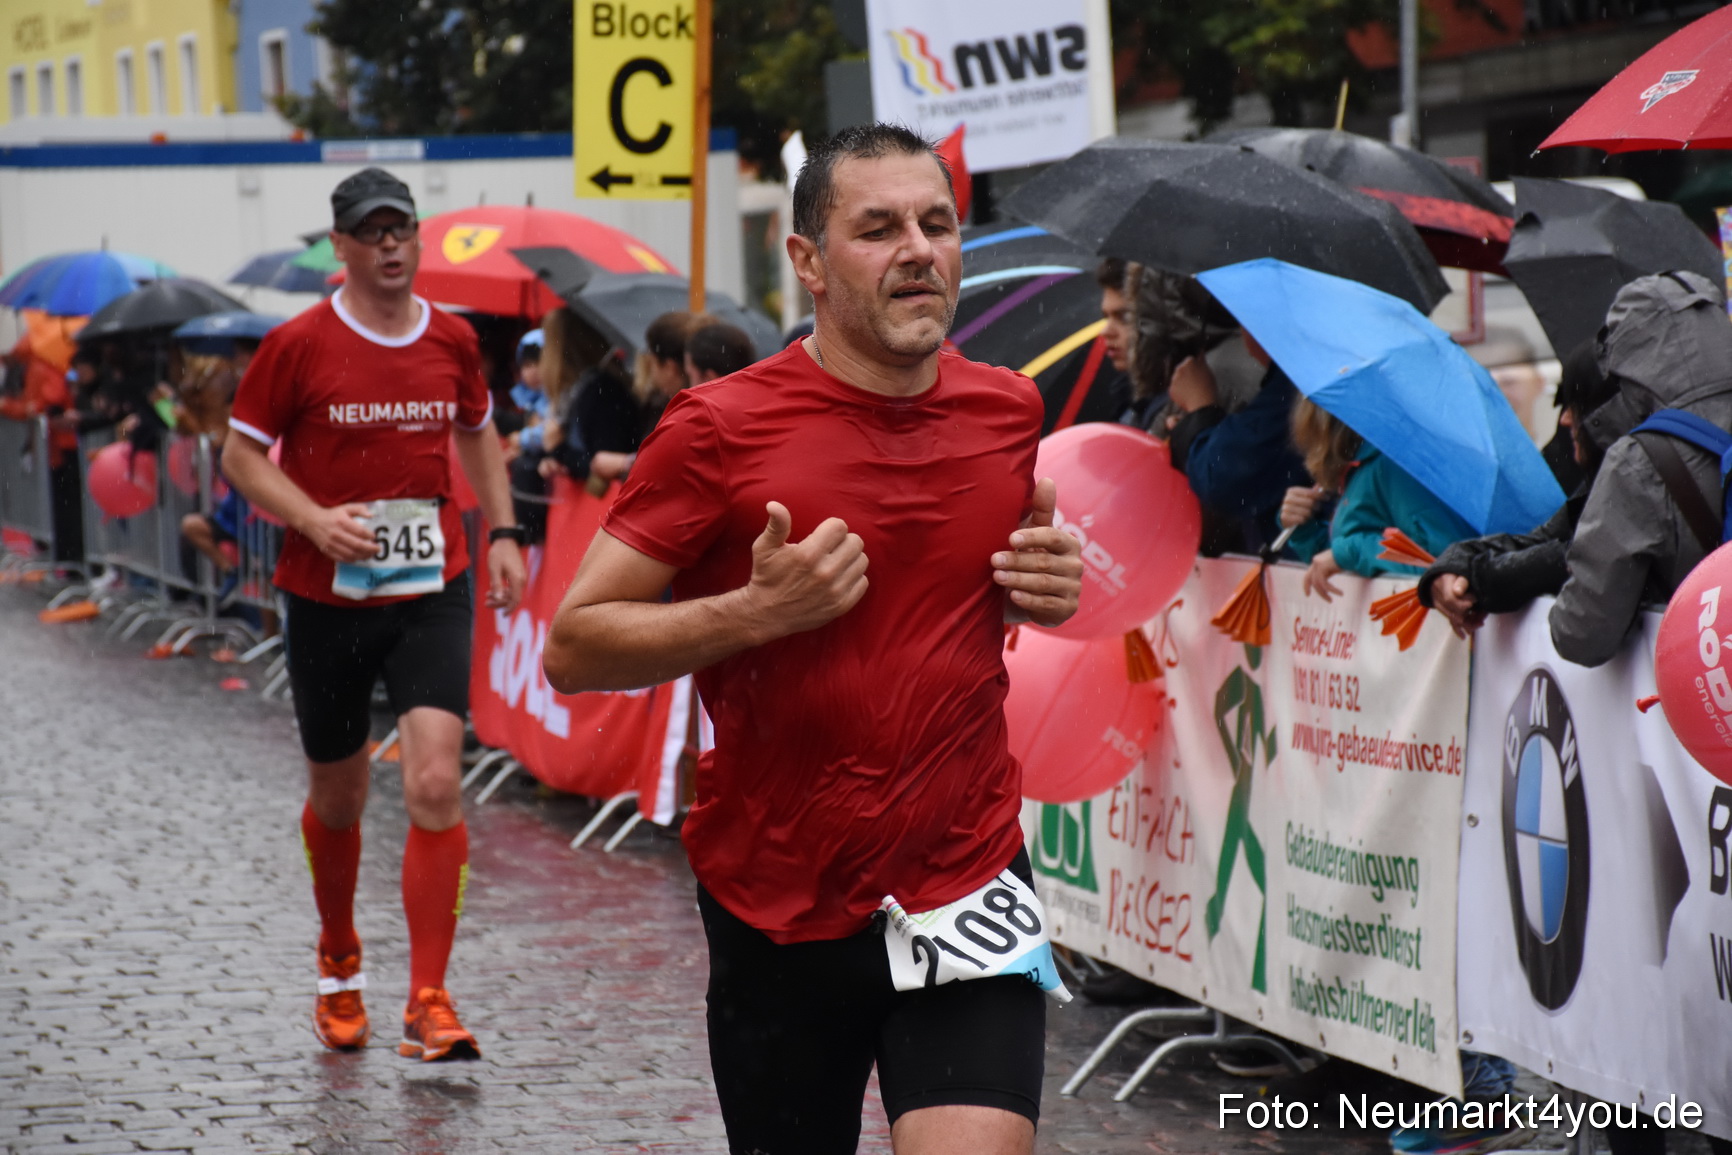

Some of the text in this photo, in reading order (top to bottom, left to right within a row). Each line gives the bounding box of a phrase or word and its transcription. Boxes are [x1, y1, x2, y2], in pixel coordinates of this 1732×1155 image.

[592, 2, 696, 40] Block
[608, 56, 674, 157] C
[328, 402, 445, 423] NEUMARKT
[1346, 676, 1362, 712] 52
[1505, 676, 1579, 790] BMW
[1286, 820, 1420, 908] Gebäudereinigung
[1287, 892, 1422, 971] Hausmeisterdienst
[1289, 964, 1436, 1053] Arbeitsbühnenverleih
